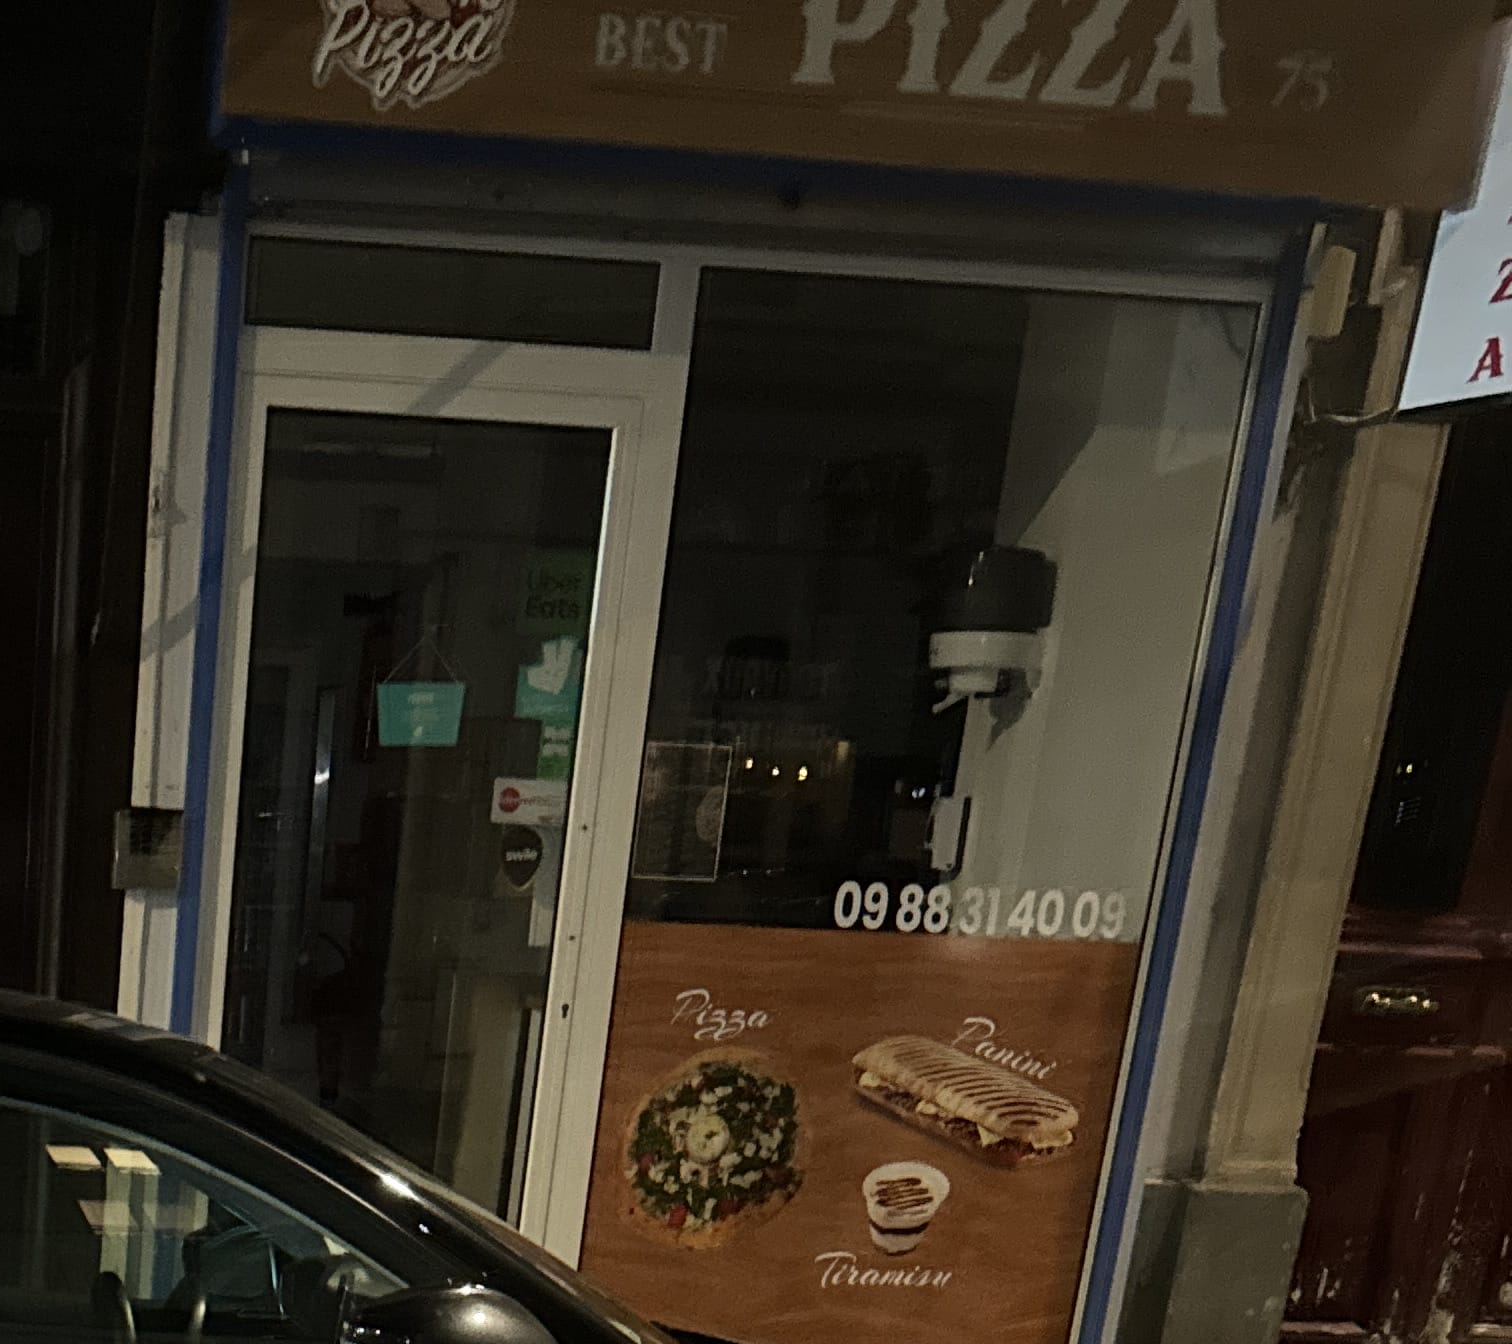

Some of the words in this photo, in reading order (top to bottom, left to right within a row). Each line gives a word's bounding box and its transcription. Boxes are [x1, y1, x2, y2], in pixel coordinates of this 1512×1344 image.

[313, 0, 494, 98] Pizza
[594, 11, 729, 75] BEST
[790, 0, 1229, 116] PIZZA
[833, 879, 889, 930] 09
[894, 882, 952, 934] 88
[958, 885, 1001, 937] 31
[1006, 888, 1066, 938] 40
[1070, 890, 1128, 939] 09
[669, 987, 774, 1042] Pizza
[950, 1015, 1058, 1080] Panini
[813, 1250, 954, 1289] Tiramisu
